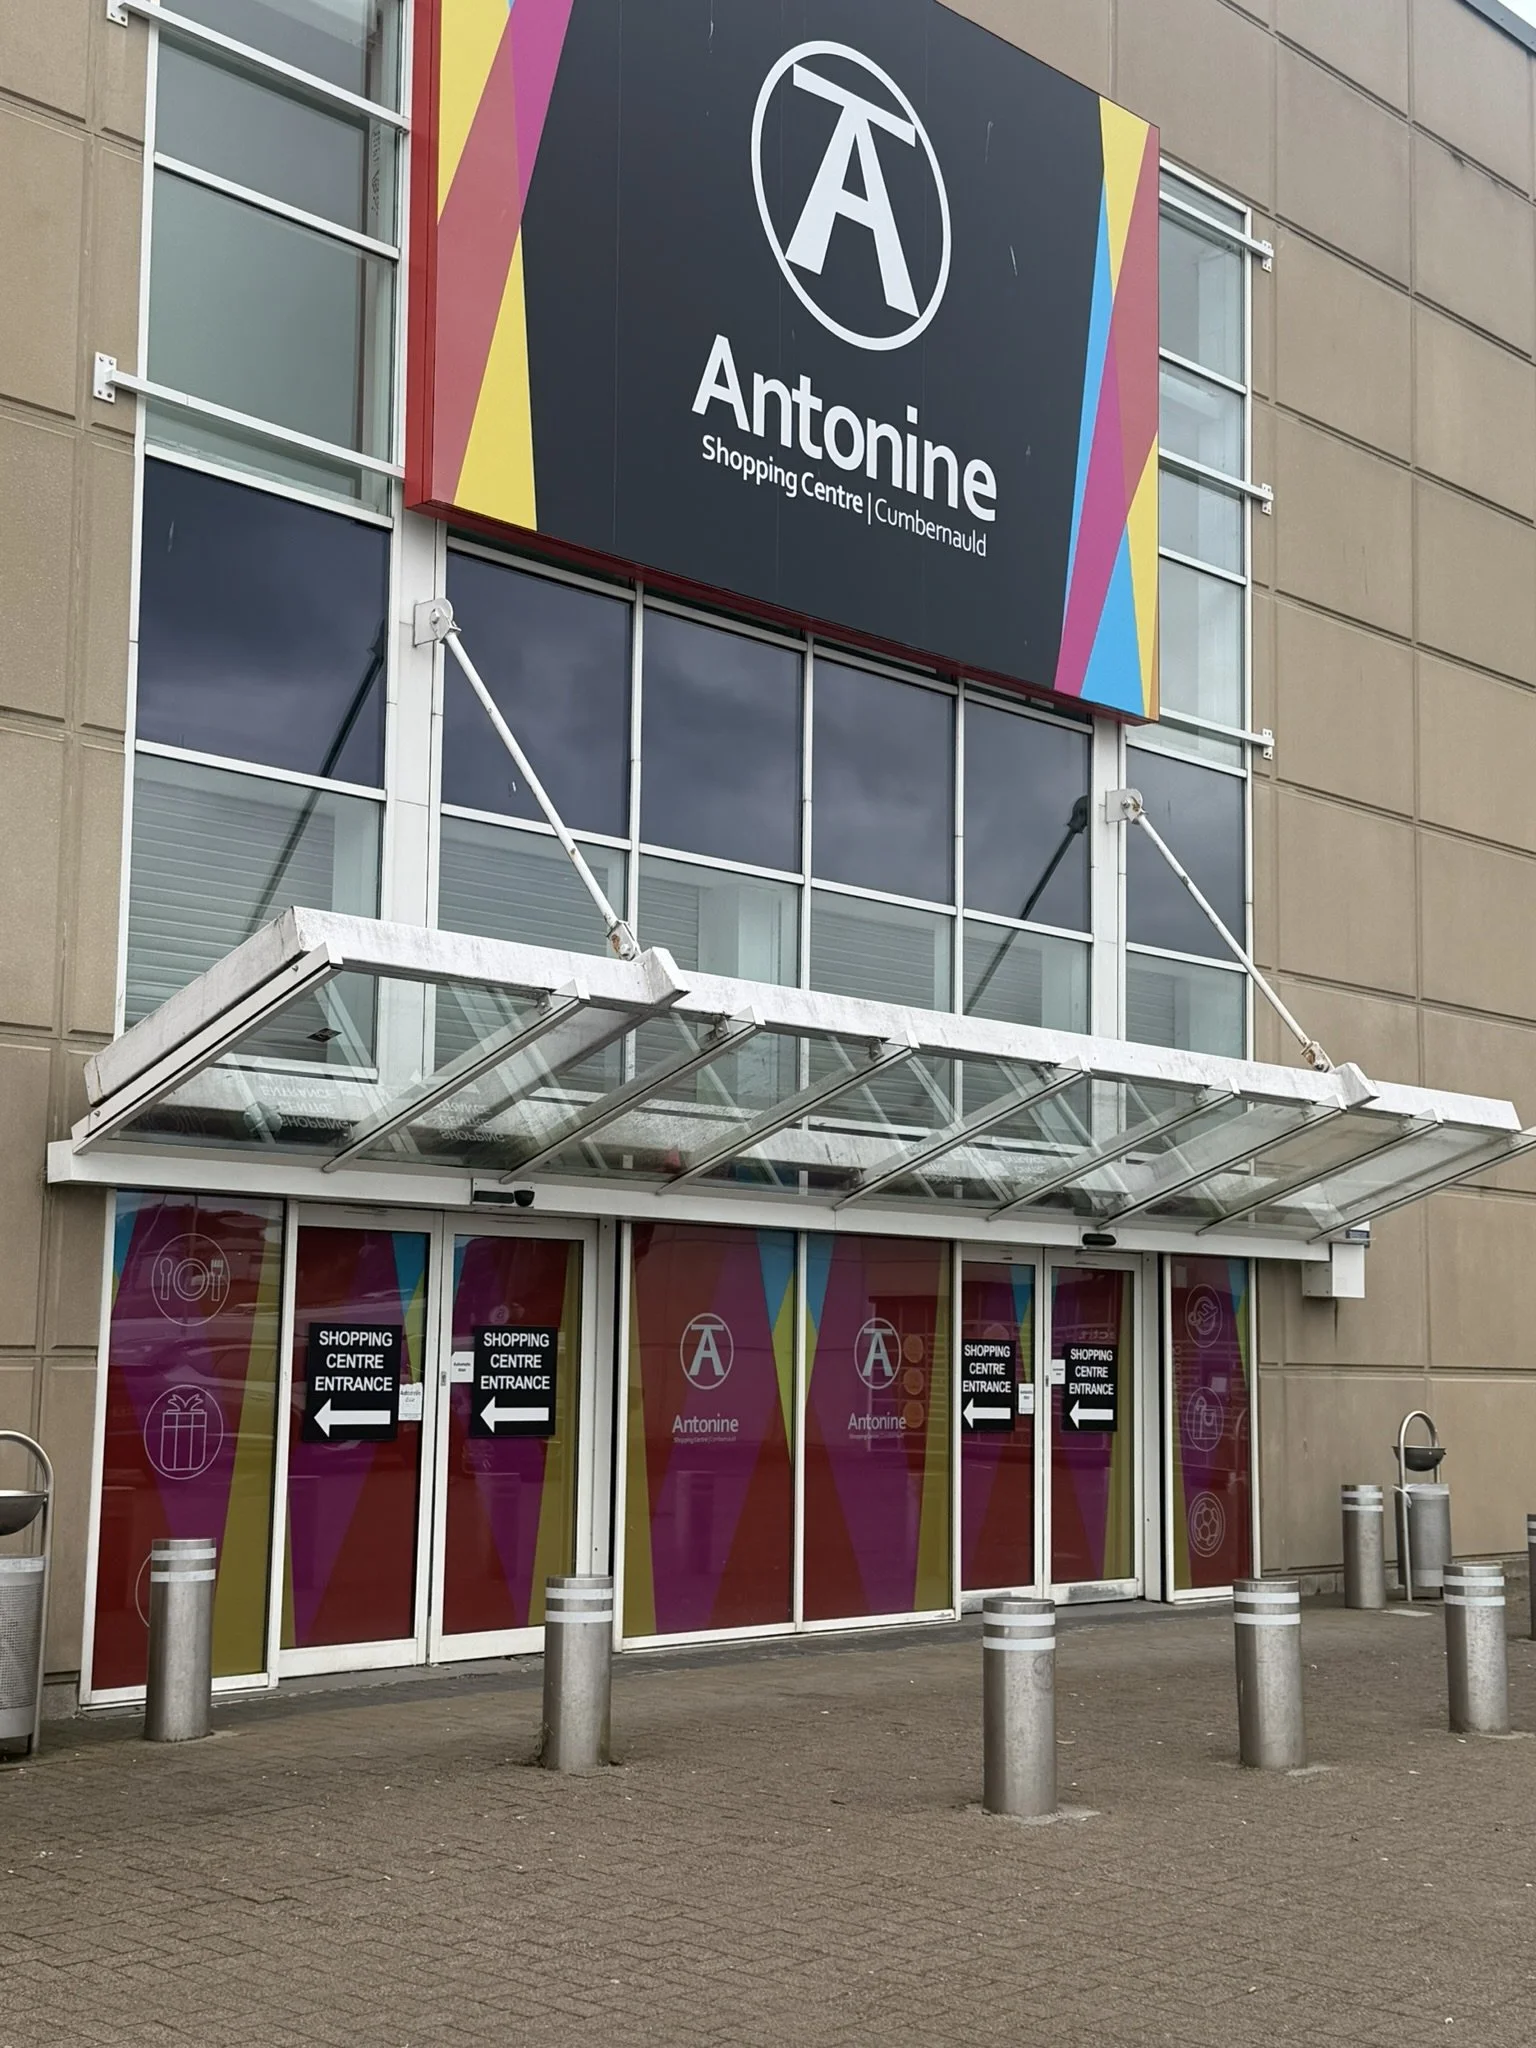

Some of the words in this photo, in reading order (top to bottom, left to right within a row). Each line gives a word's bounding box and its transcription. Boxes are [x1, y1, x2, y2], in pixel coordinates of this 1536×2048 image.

[691, 334, 997, 522] Antonine
[702, 434, 797, 498] Shopping
[801, 472, 864, 514] Centre
[874, 499, 987, 557] Cumbernauld
[319, 1330, 393, 1347] SHOPPING
[483, 1332, 550, 1348] SHOPPING
[964, 1344, 1011, 1358] SHOPPING
[1070, 1348, 1113, 1362] SHOPPING
[326, 1353, 384, 1369] CENTRE
[490, 1354, 542, 1369] CENTRE
[969, 1362, 1006, 1376] CENTRE
[1075, 1365, 1108, 1378] CENTRE
[314, 1376, 392, 1392] ENTRANCE
[480, 1375, 550, 1390] ENTRANCE
[962, 1380, 1012, 1393] ENTRANCE
[1068, 1382, 1114, 1395] ENTRANCE
[672, 1413, 740, 1434] Antonine
[848, 1411, 907, 1432] Antonine
